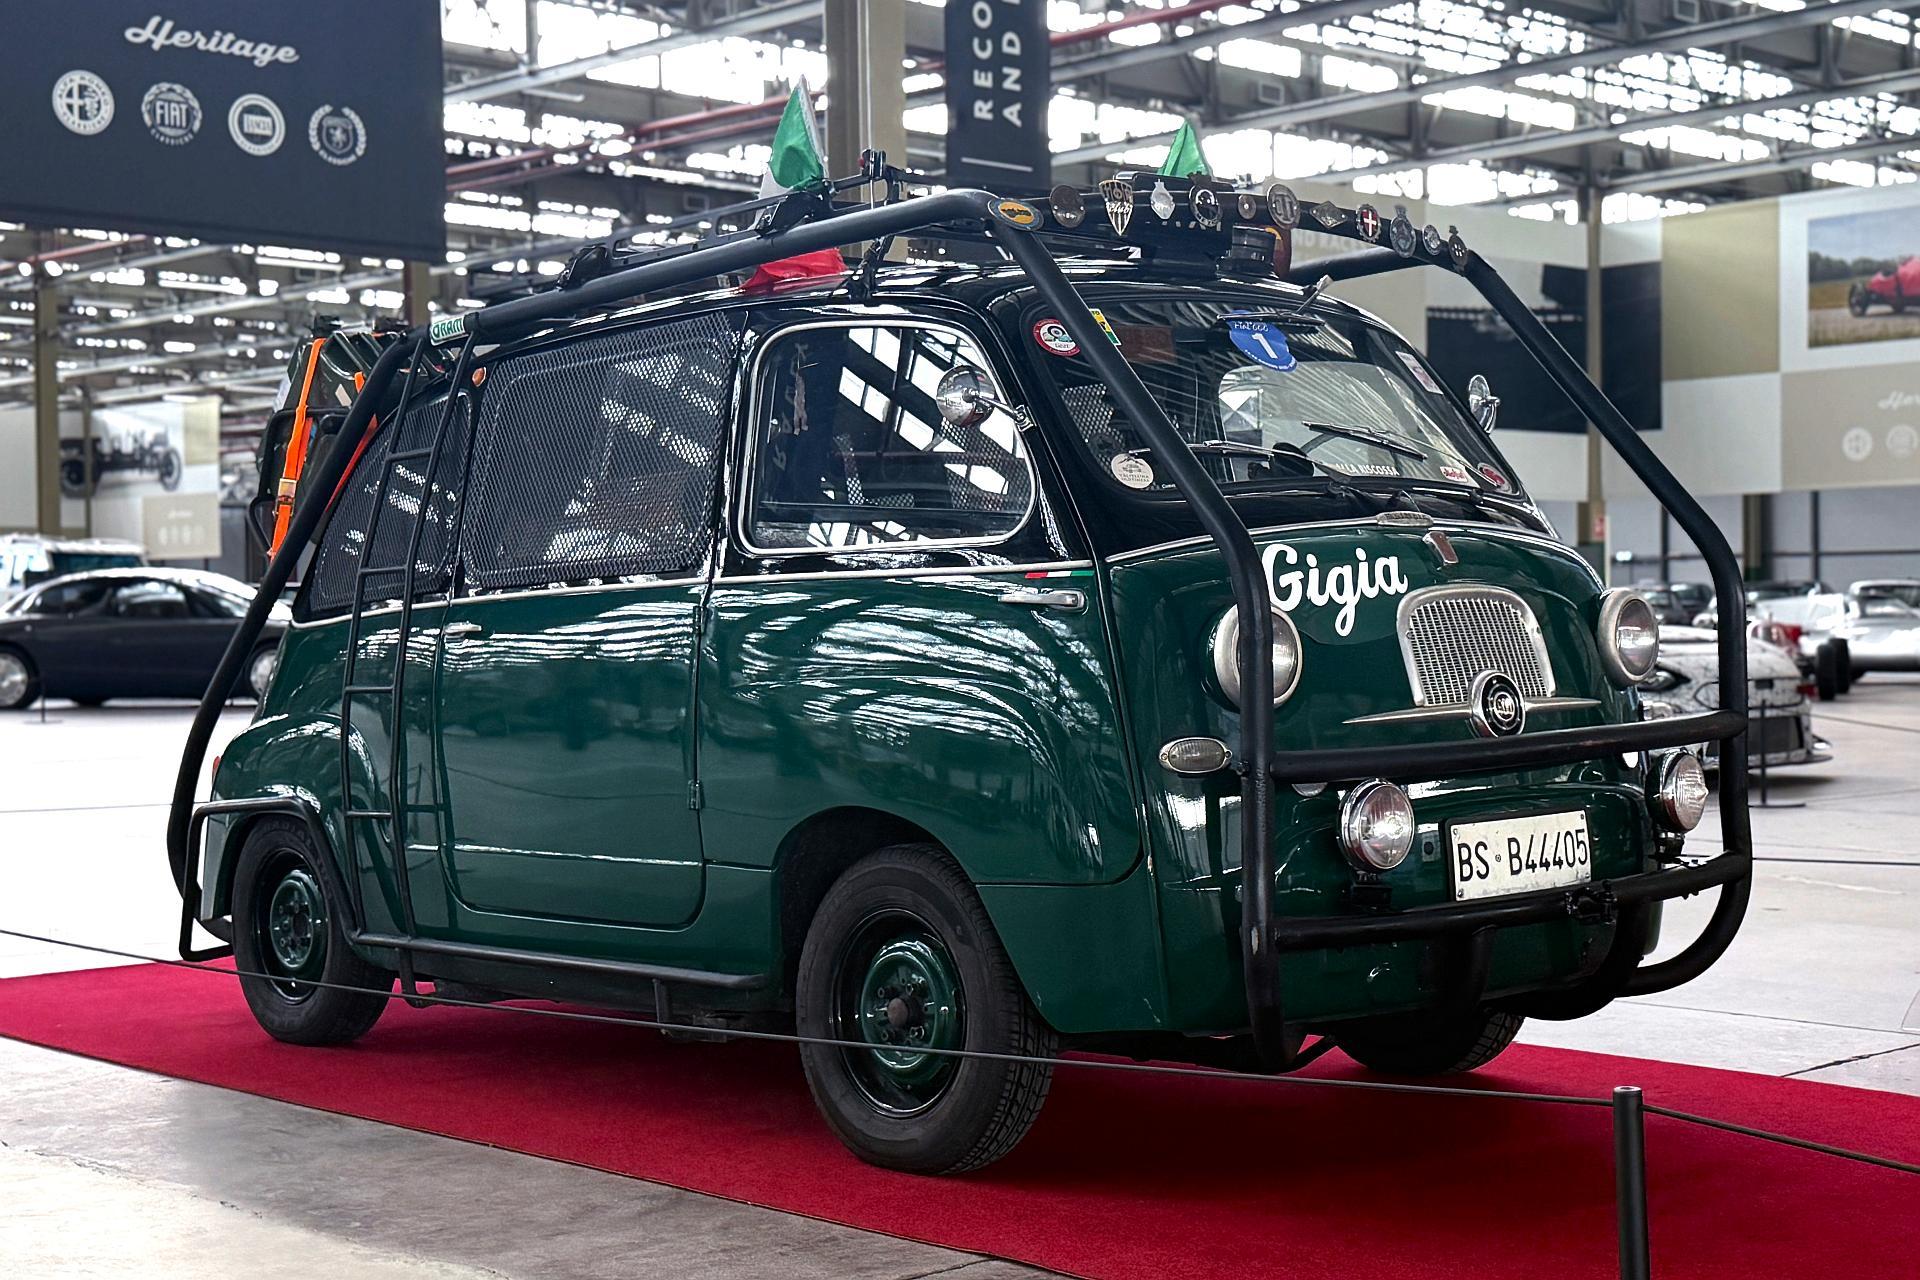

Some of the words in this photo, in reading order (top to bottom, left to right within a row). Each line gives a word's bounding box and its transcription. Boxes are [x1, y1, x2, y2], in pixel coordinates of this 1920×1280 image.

[124, 15, 300, 67] Heritage
[1001, 31, 1023, 128] AND
[155, 99, 188, 129] FIAT
[1251, 332, 1279, 360] 1
[1261, 543, 1409, 637] Gigia
[1457, 841, 1490, 882] BS
[1507, 828, 1588, 876] B44405
